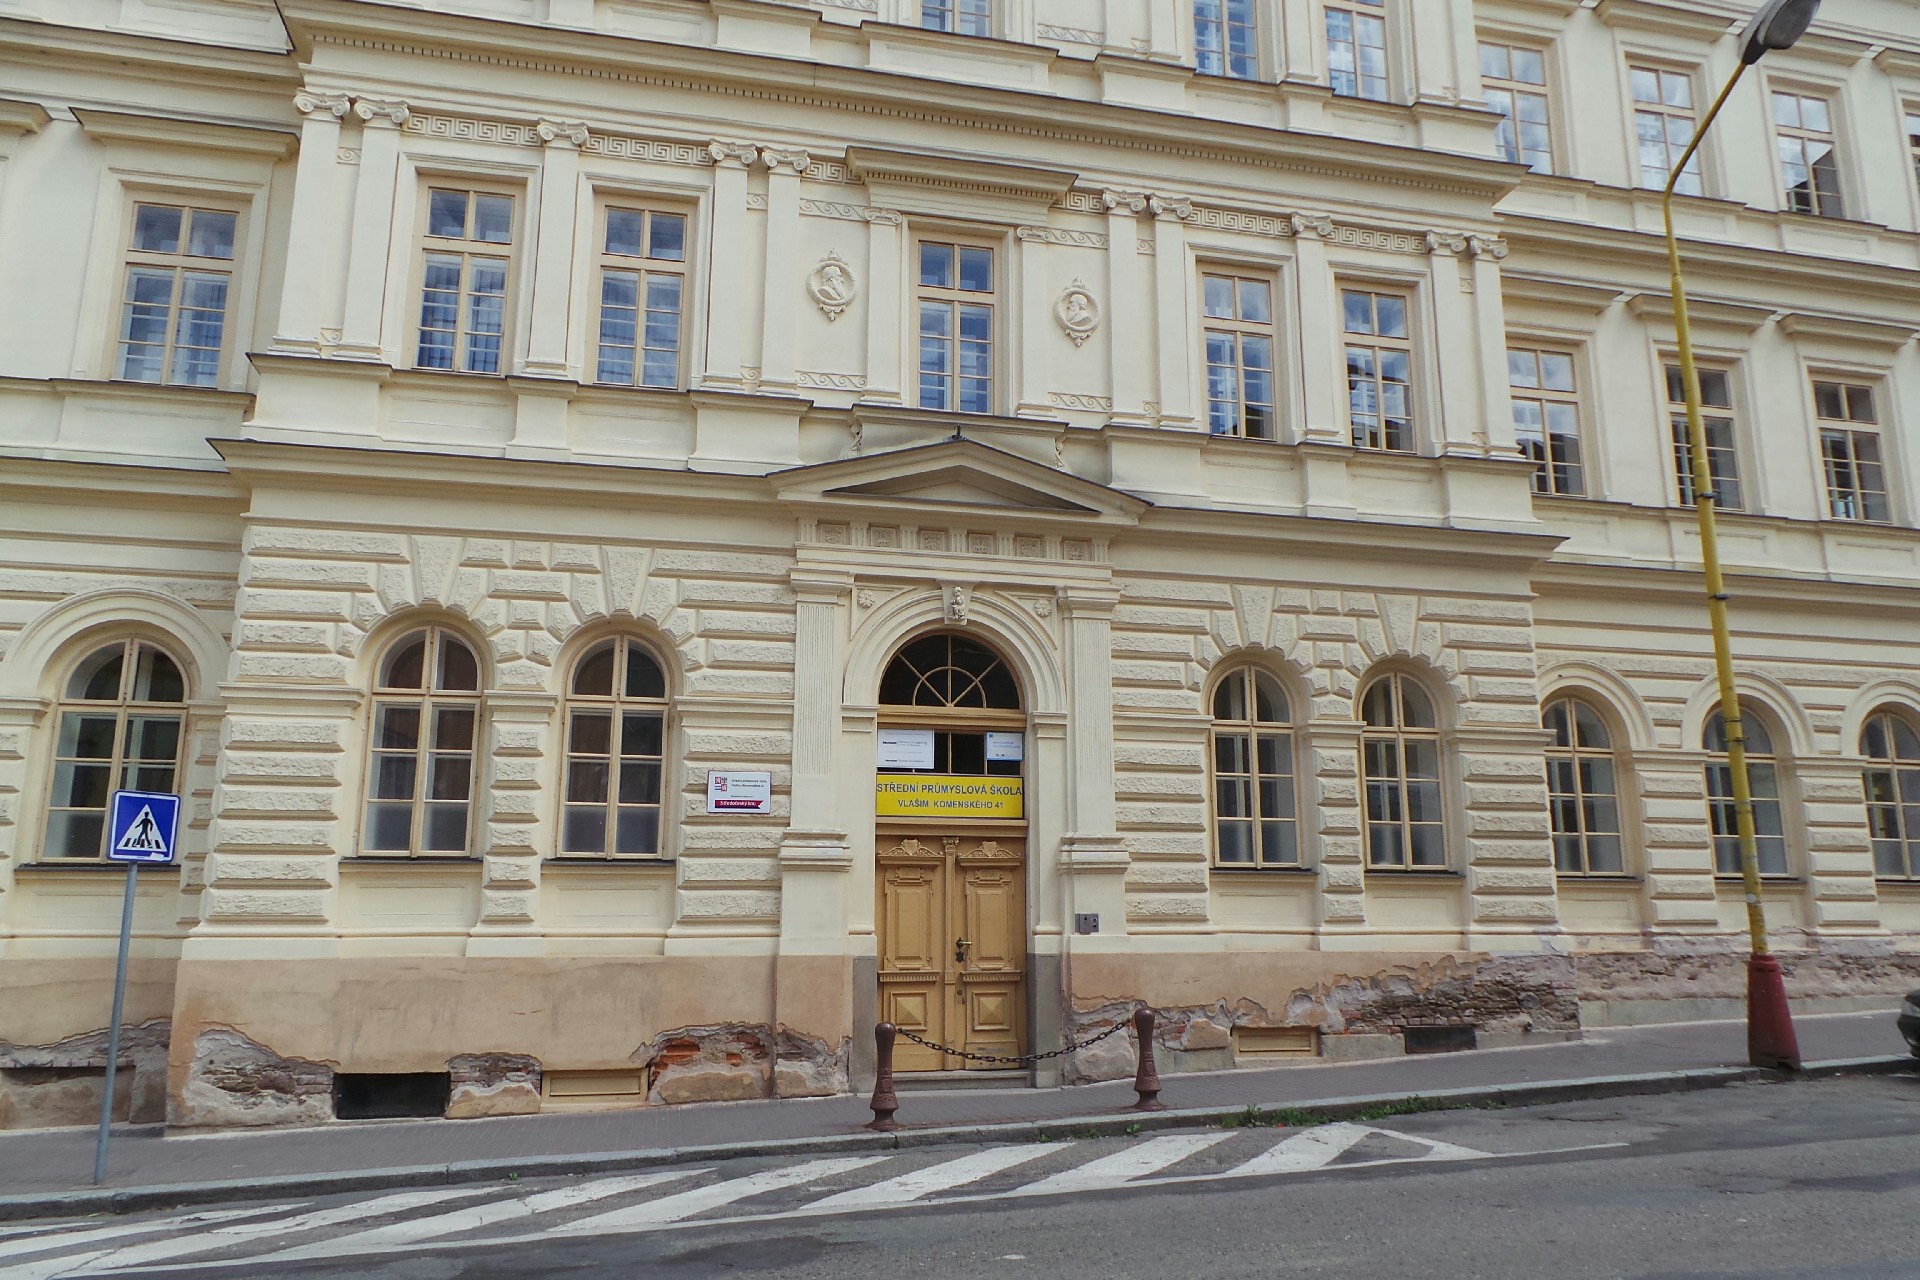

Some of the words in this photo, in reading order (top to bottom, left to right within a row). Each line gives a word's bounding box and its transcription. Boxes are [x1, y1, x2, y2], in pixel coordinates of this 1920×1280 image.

[876, 781, 919, 793] STŘEDNÍ
[921, 782, 987, 795] PRŮMYSLOVÁ
[990, 785, 1022, 796] ŠKOLA
[933, 799, 993, 809] KOMENSKÉHO
